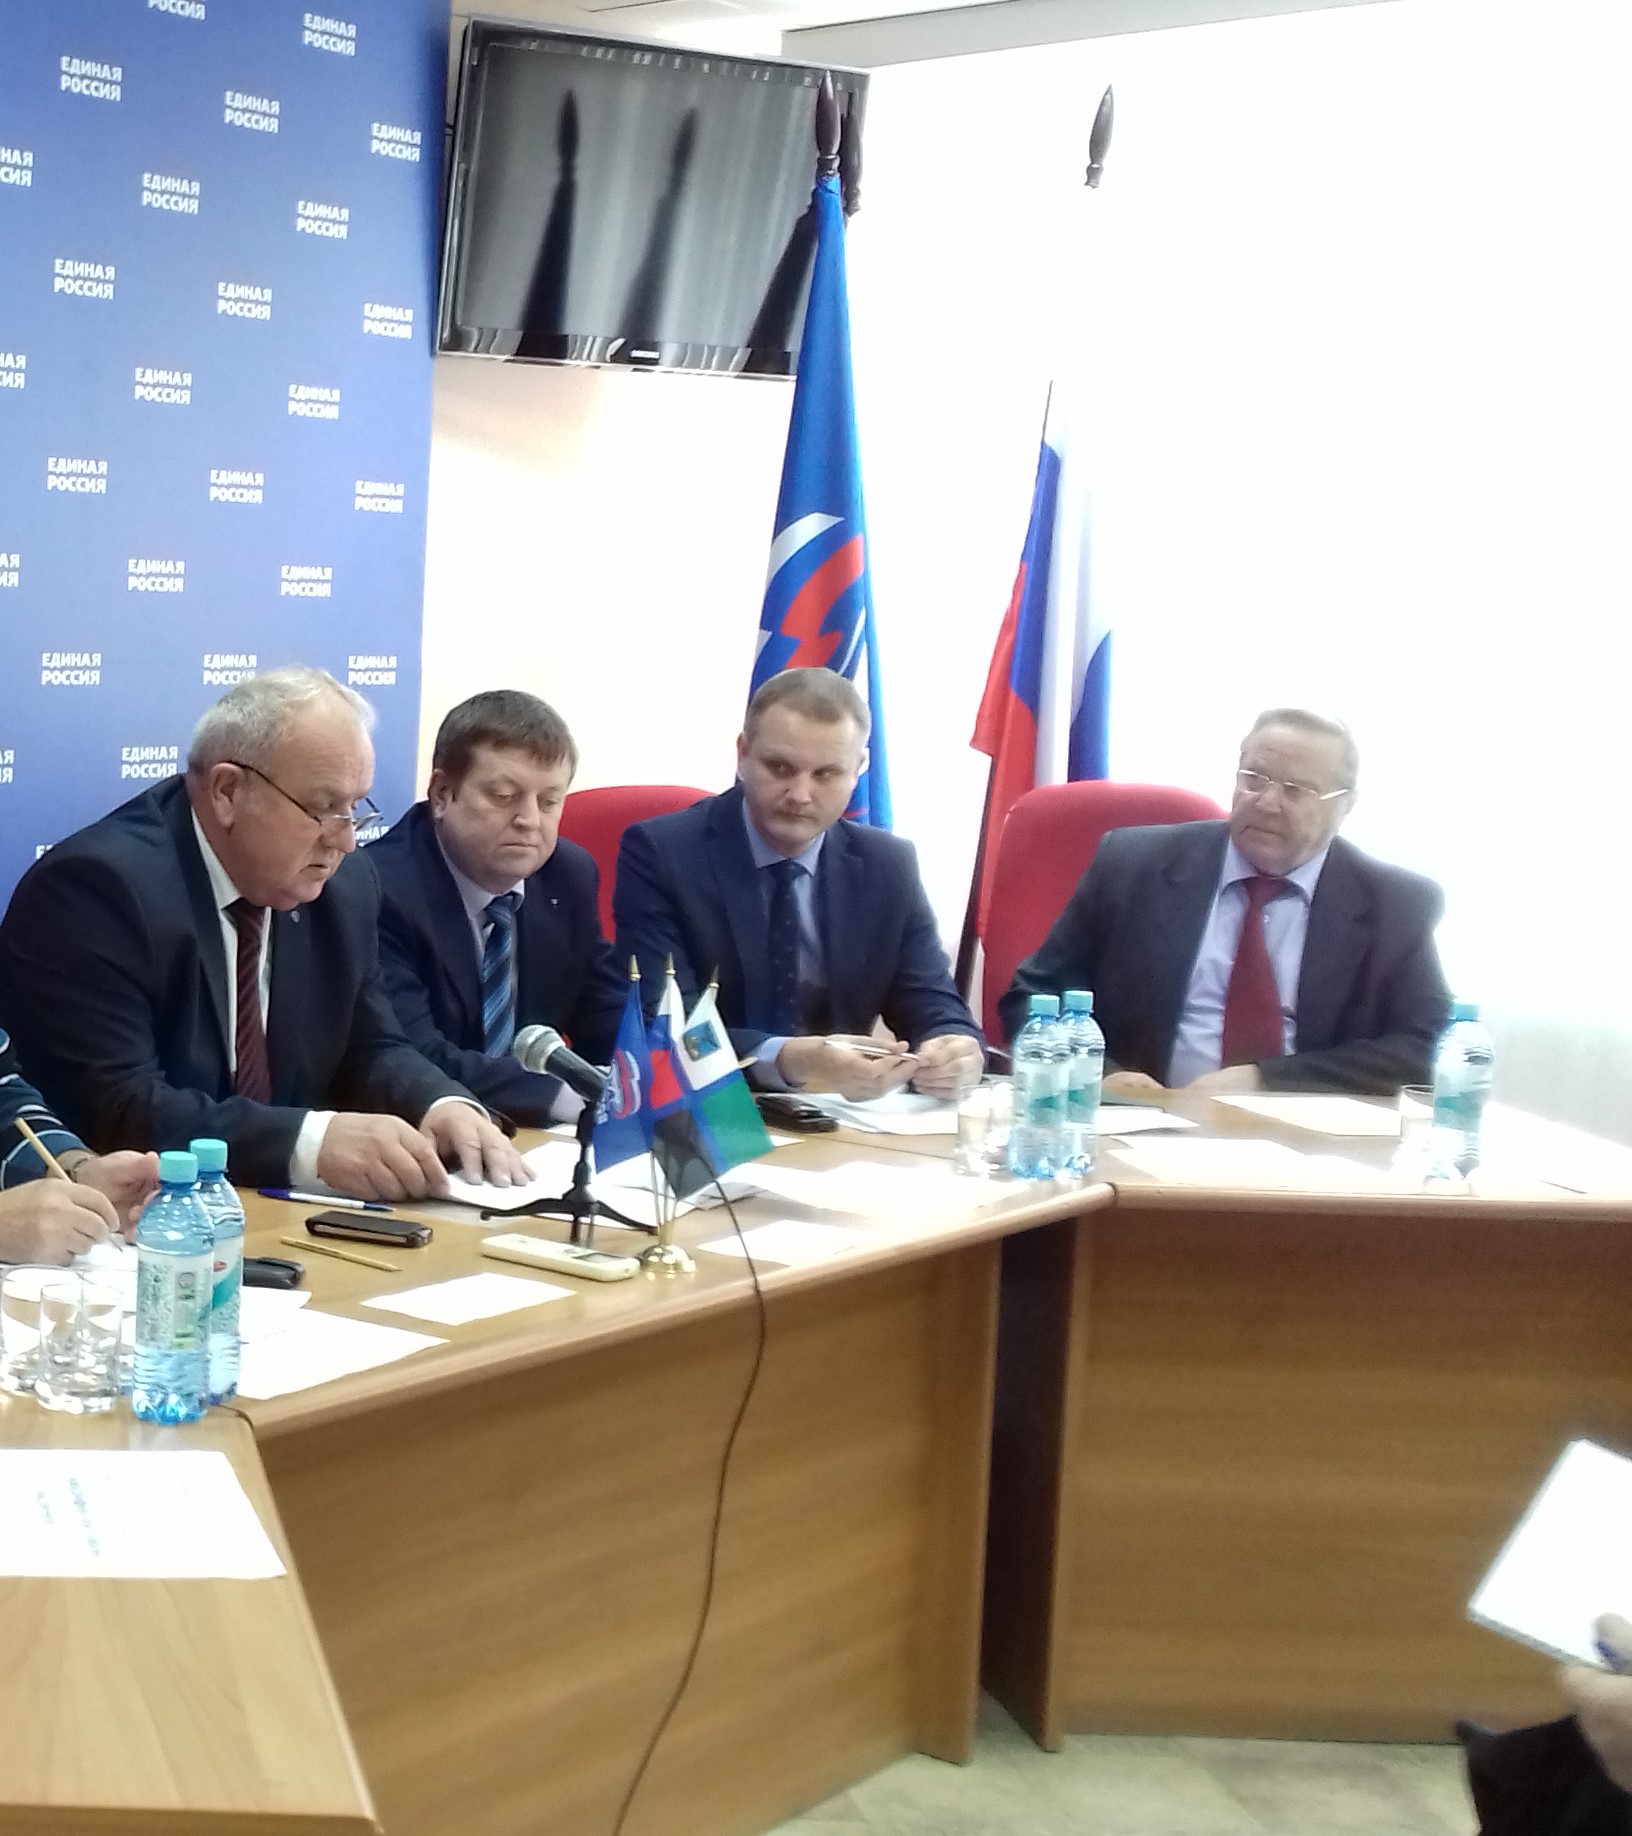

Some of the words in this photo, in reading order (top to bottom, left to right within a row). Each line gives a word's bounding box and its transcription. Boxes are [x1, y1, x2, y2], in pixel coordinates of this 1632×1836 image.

[303, 13, 356, 38] ЕДИНАЯ
[303, 30, 355, 56] РОССИЯ
[60, 56, 122, 82] ЕДИНАЯ
[60, 74, 121, 101] РОССИЯ
[225, 91, 280, 115] ЕДИНАЯ
[224, 108, 279, 133] РОССИЯ
[371, 122, 422, 145] ЕДИНАЯ
[371, 139, 420, 162] РОССИЯ
[142, 172, 200, 196] ЕДИНАЯ
[142, 190, 199, 214] РОССИЯ
[297, 200, 349, 222] ЕДИНАЯ
[296, 217, 348, 239] РОССИЯ
[54, 259, 115, 280] ЕДИНАЯ
[54, 277, 114, 299] РОССИЯ
[218, 282, 272, 302] ЕДИНАЯ
[218, 299, 271, 320] РОССИЯ
[364, 303, 413, 322] ЕДИНАЯ
[364, 319, 412, 339] РОССИЯ
[135, 368, 192, 386] ЕДИНАЯ
[135, 385, 191, 405] РОССИЯ
[289, 385, 340, 402] ЕДИНАЯ
[288, 399, 339, 419] РОССИЯ
[48, 457, 107, 475] ЕДИНАЯ
[47, 475, 106, 493] РОССИЯ
[210, 470, 264, 486] ЕДИНАЯ
[210, 486, 262, 503] РОССИЯ
[356, 481, 404, 496] ЕДИНАЯ
[355, 496, 403, 513] РОССИЯ
[128, 559, 185, 575] ЕДИНАЯ
[281, 566, 332, 580] ЕДИНАЯ
[128, 576, 183, 592] РОССИЯ
[281, 582, 331, 597] РОССИЯ
[42, 652, 101, 668] ЕДИНАЯ
[203, 654, 257, 669] ЕДИНАЯ
[348, 656, 397, 670] ЕДИНАЯ
[41, 670, 100, 685] РОССИЯ
[348, 671, 396, 686] РОССИЯ
[121, 746, 179, 761] ЕДИНАЯ
[121, 763, 177, 779] РОССИЯ
